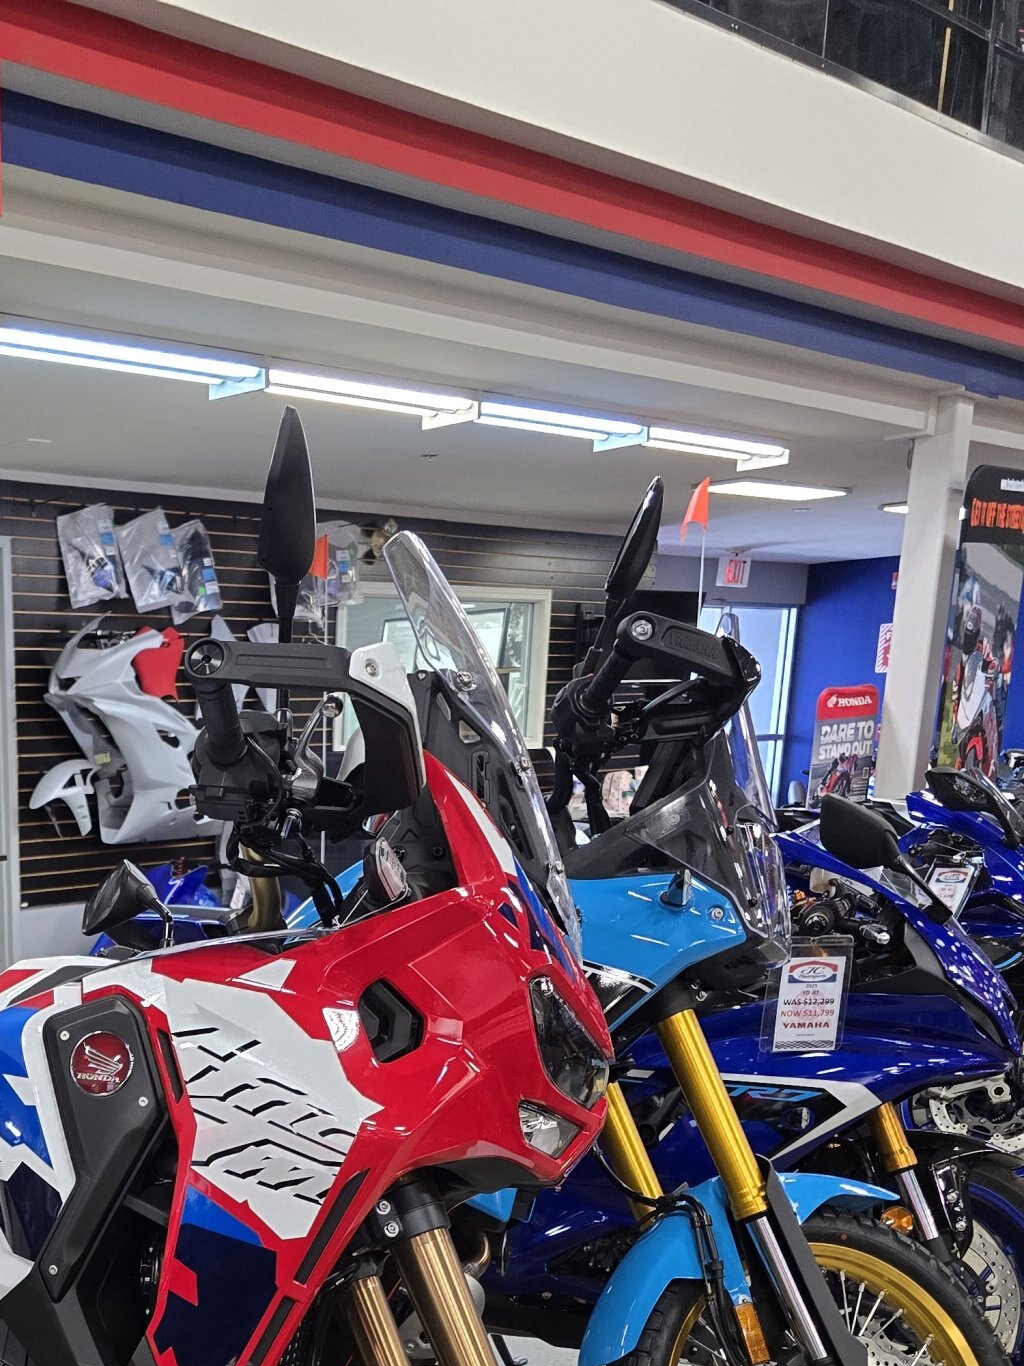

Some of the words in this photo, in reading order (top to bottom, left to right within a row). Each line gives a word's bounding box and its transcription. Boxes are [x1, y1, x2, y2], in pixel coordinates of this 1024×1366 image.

[726, 559, 748, 584] EXIT
[837, 695, 872, 707] HONDA
[821, 722, 856, 744] DARE
[857, 720, 874, 739] TO
[819, 741, 851, 760] STAND
[851, 740, 872, 757] OUT
[783, 998, 801, 1006] WAS
[803, 998, 835, 1007] $12,299
[781, 1009, 802, 1018] NOW
[803, 1008, 835, 1018] $11,799
[782, 1022, 830, 1030] YAMAHA
[76, 1071, 121, 1084] HONDA
